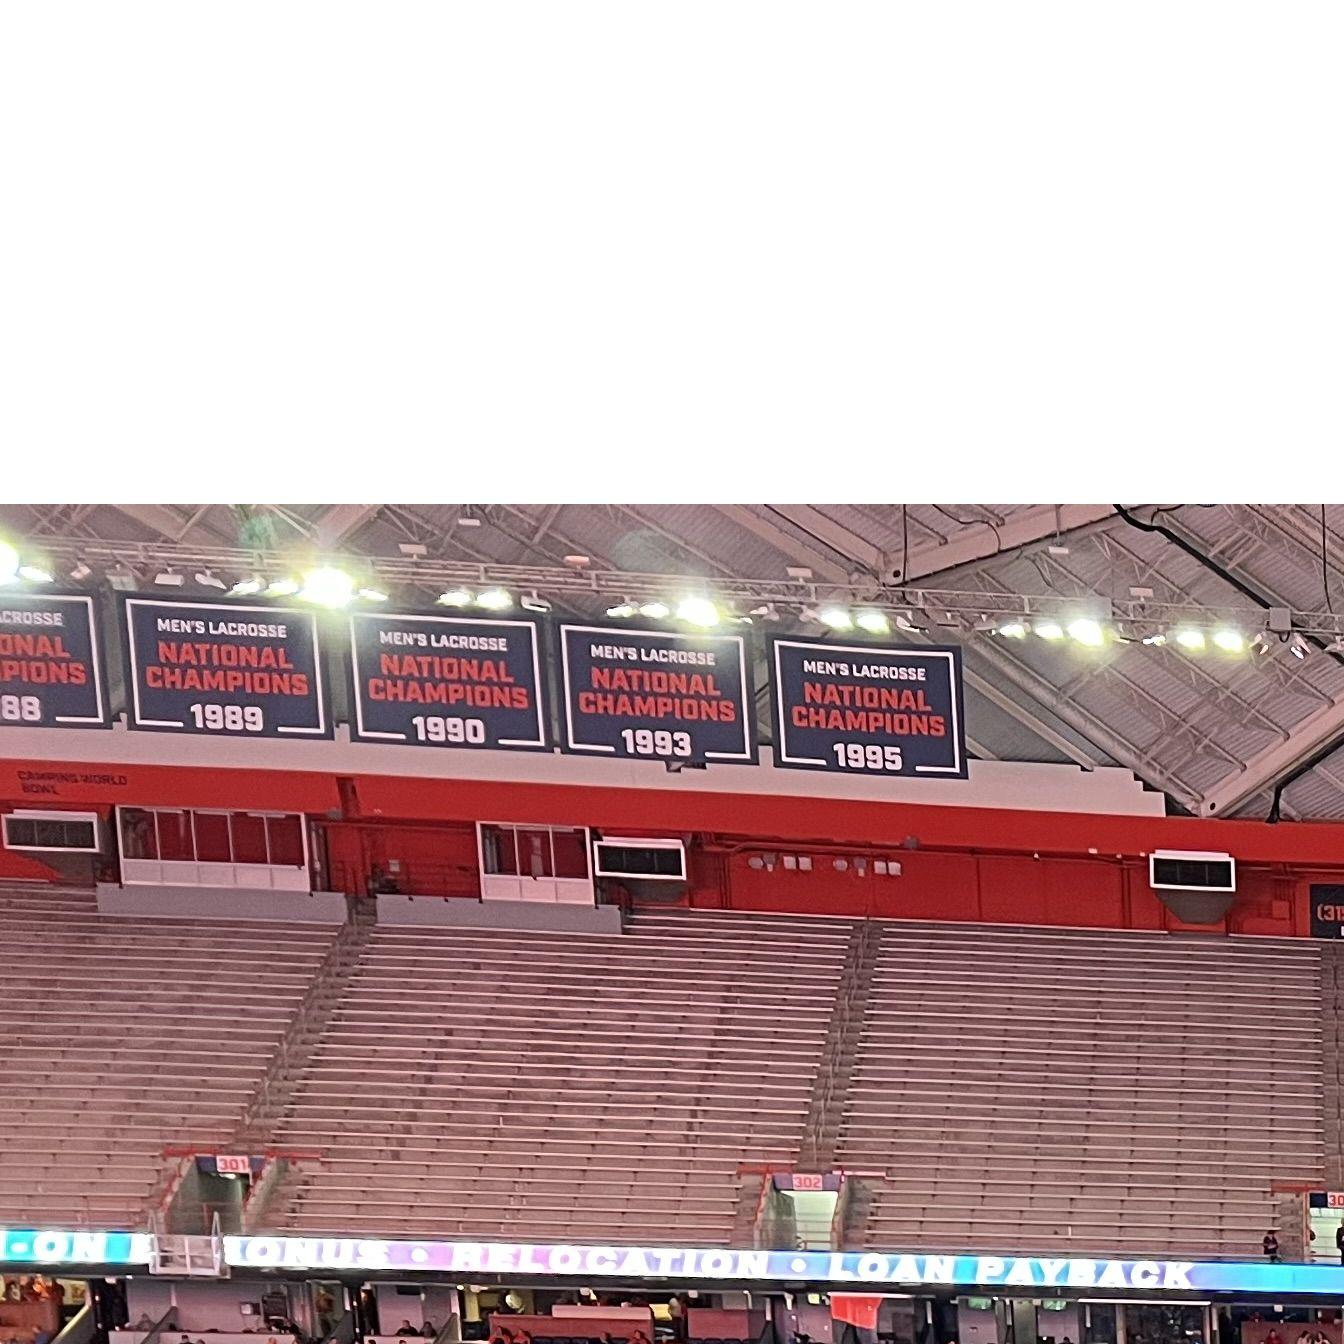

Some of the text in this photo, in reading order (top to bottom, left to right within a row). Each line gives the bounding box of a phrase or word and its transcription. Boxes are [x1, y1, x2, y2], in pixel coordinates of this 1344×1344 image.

[157, 618, 288, 639] MEN'S LACROSSE
[379, 630, 508, 651] MEN'S LACROSSE
[157, 640, 294, 669] NATIONAL
[379, 653, 515, 683] NATIONAL
[590, 644, 716, 666] MEN'S LACROSSE
[146, 666, 310, 696] CHAMPIONS
[590, 666, 721, 697] NATIONAL
[803, 659, 926, 681] MEN'S LACROSSE
[368, 678, 529, 709] CHAMPIONS
[578, 692, 736, 722] CHAMPIONS
[803, 681, 933, 712] NATIONAL
[190, 703, 264, 732] 1989
[412, 716, 486, 744] 1990
[791, 706, 946, 737] CHAMPIONS
[621, 728, 692, 757] 1993
[832, 742, 903, 771] 1995
[217, 1156, 248, 1172] 301
[794, 1175, 822, 1190] 302
[452, 1243, 769, 1276] RELOCATION
[829, 1252, 955, 1283] LOAN
[975, 1257, 1198, 1290] PAYBACK
